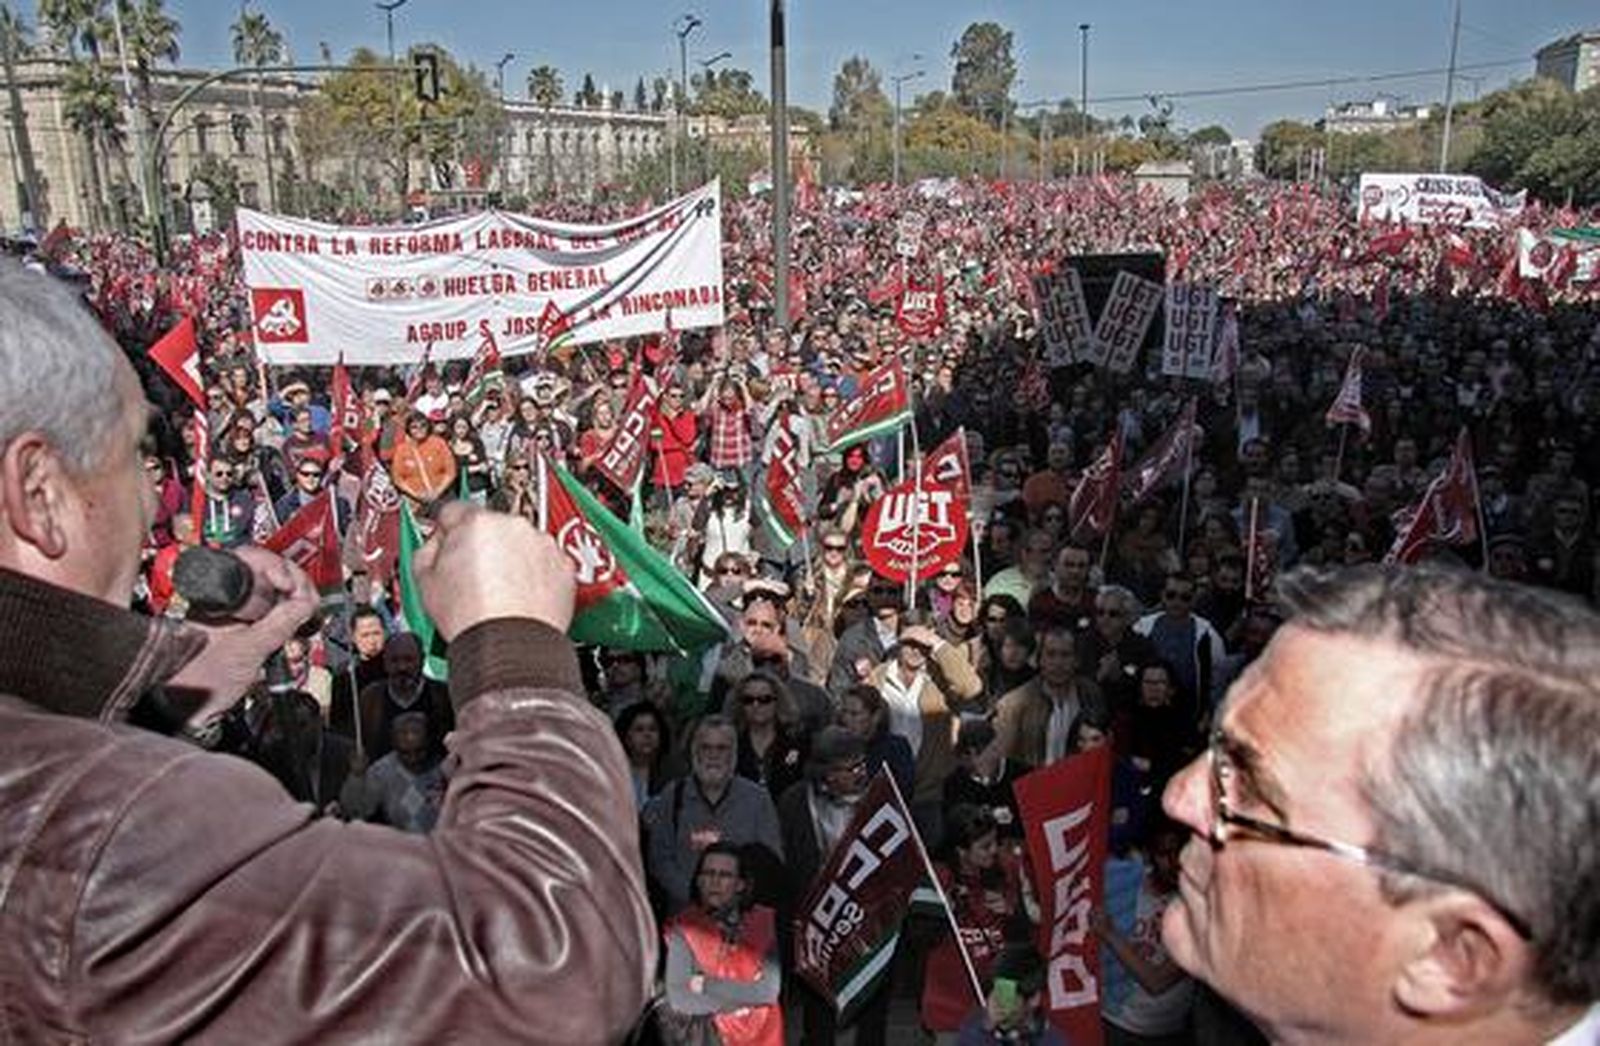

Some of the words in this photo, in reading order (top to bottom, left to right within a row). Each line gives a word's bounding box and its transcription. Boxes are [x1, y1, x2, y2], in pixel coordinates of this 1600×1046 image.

[244, 230, 319, 254] CONTRA
[331, 236, 357, 255] LA
[370, 232, 462, 255] REFORMA
[475, 230, 559, 251] LABORAL
[444, 274, 516, 297] HUELGA
[528, 267, 609, 292] GENERAL
[1116, 274, 1158, 307] UGT
[903, 290, 937, 310] UGT
[1174, 286, 1211, 306] UGT
[1108, 299, 1149, 330] UGT
[1171, 308, 1209, 329] UGT
[408, 320, 466, 343] AGRUP
[1099, 321, 1140, 350] UGT
[1169, 331, 1208, 353] UGT
[880, 490, 953, 532] UGT
